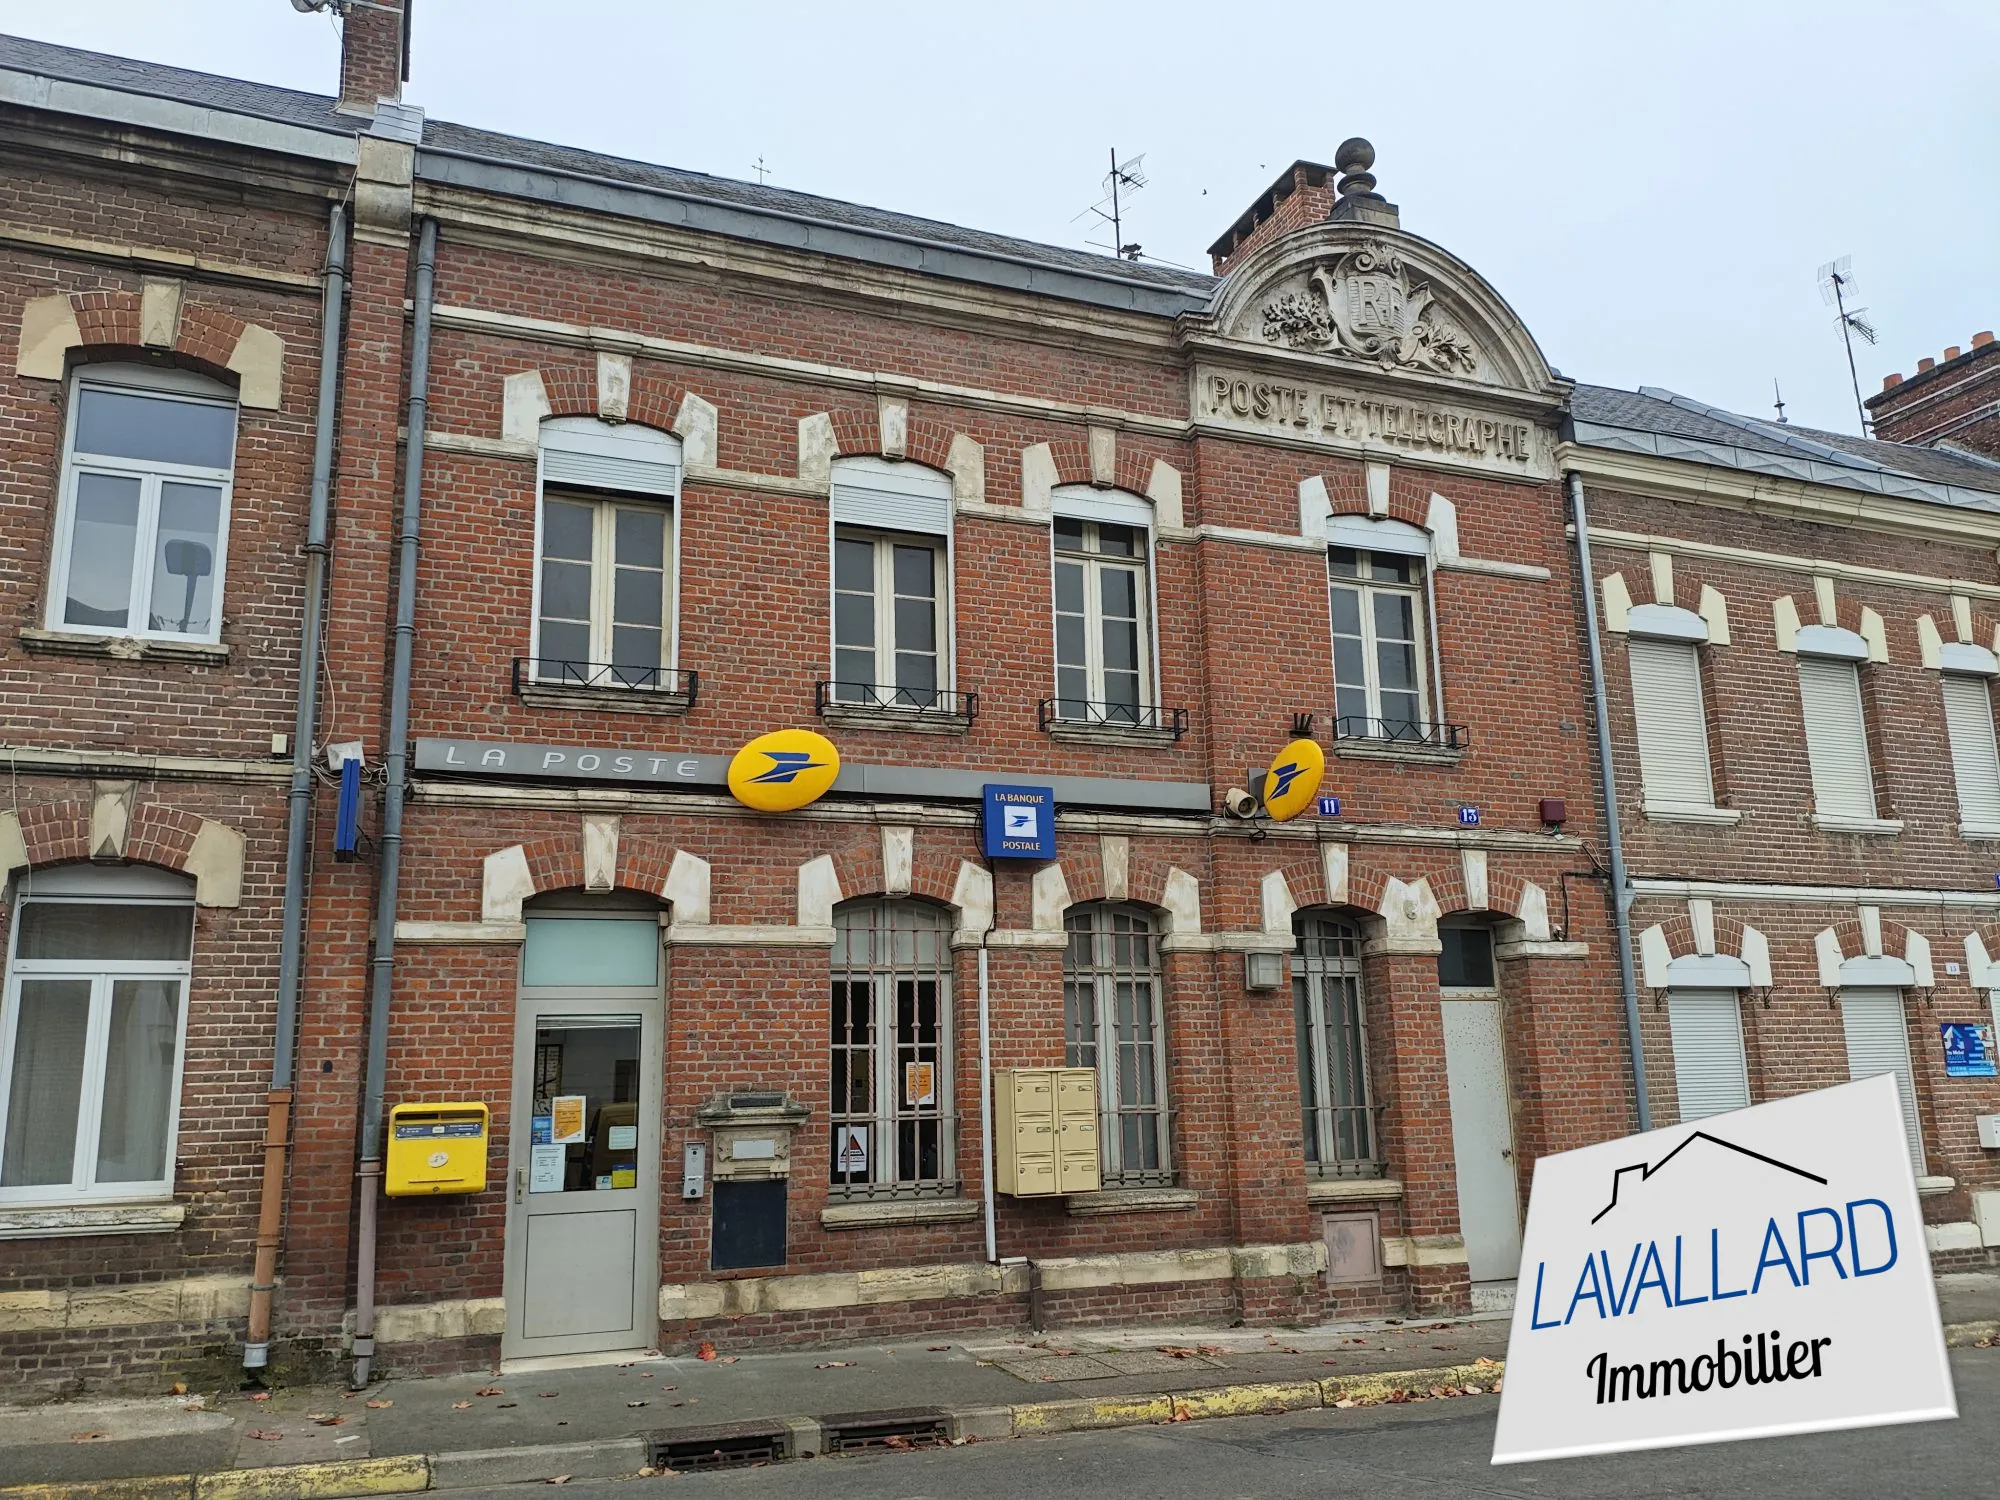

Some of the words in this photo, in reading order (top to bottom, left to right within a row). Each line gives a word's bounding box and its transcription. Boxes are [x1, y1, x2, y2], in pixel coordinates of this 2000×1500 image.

[1208, 374, 1309, 427] POSTE
[1322, 393, 1356, 433] ET
[446, 746, 506, 768] LA
[542, 751, 699, 777] POSTE
[995, 793, 1006, 802] LA
[1007, 794, 1045, 804] BANQUE
[1324, 799, 1335, 814] 11
[1462, 808, 1477, 822] 13
[1002, 840, 1041, 851] POSTALE
